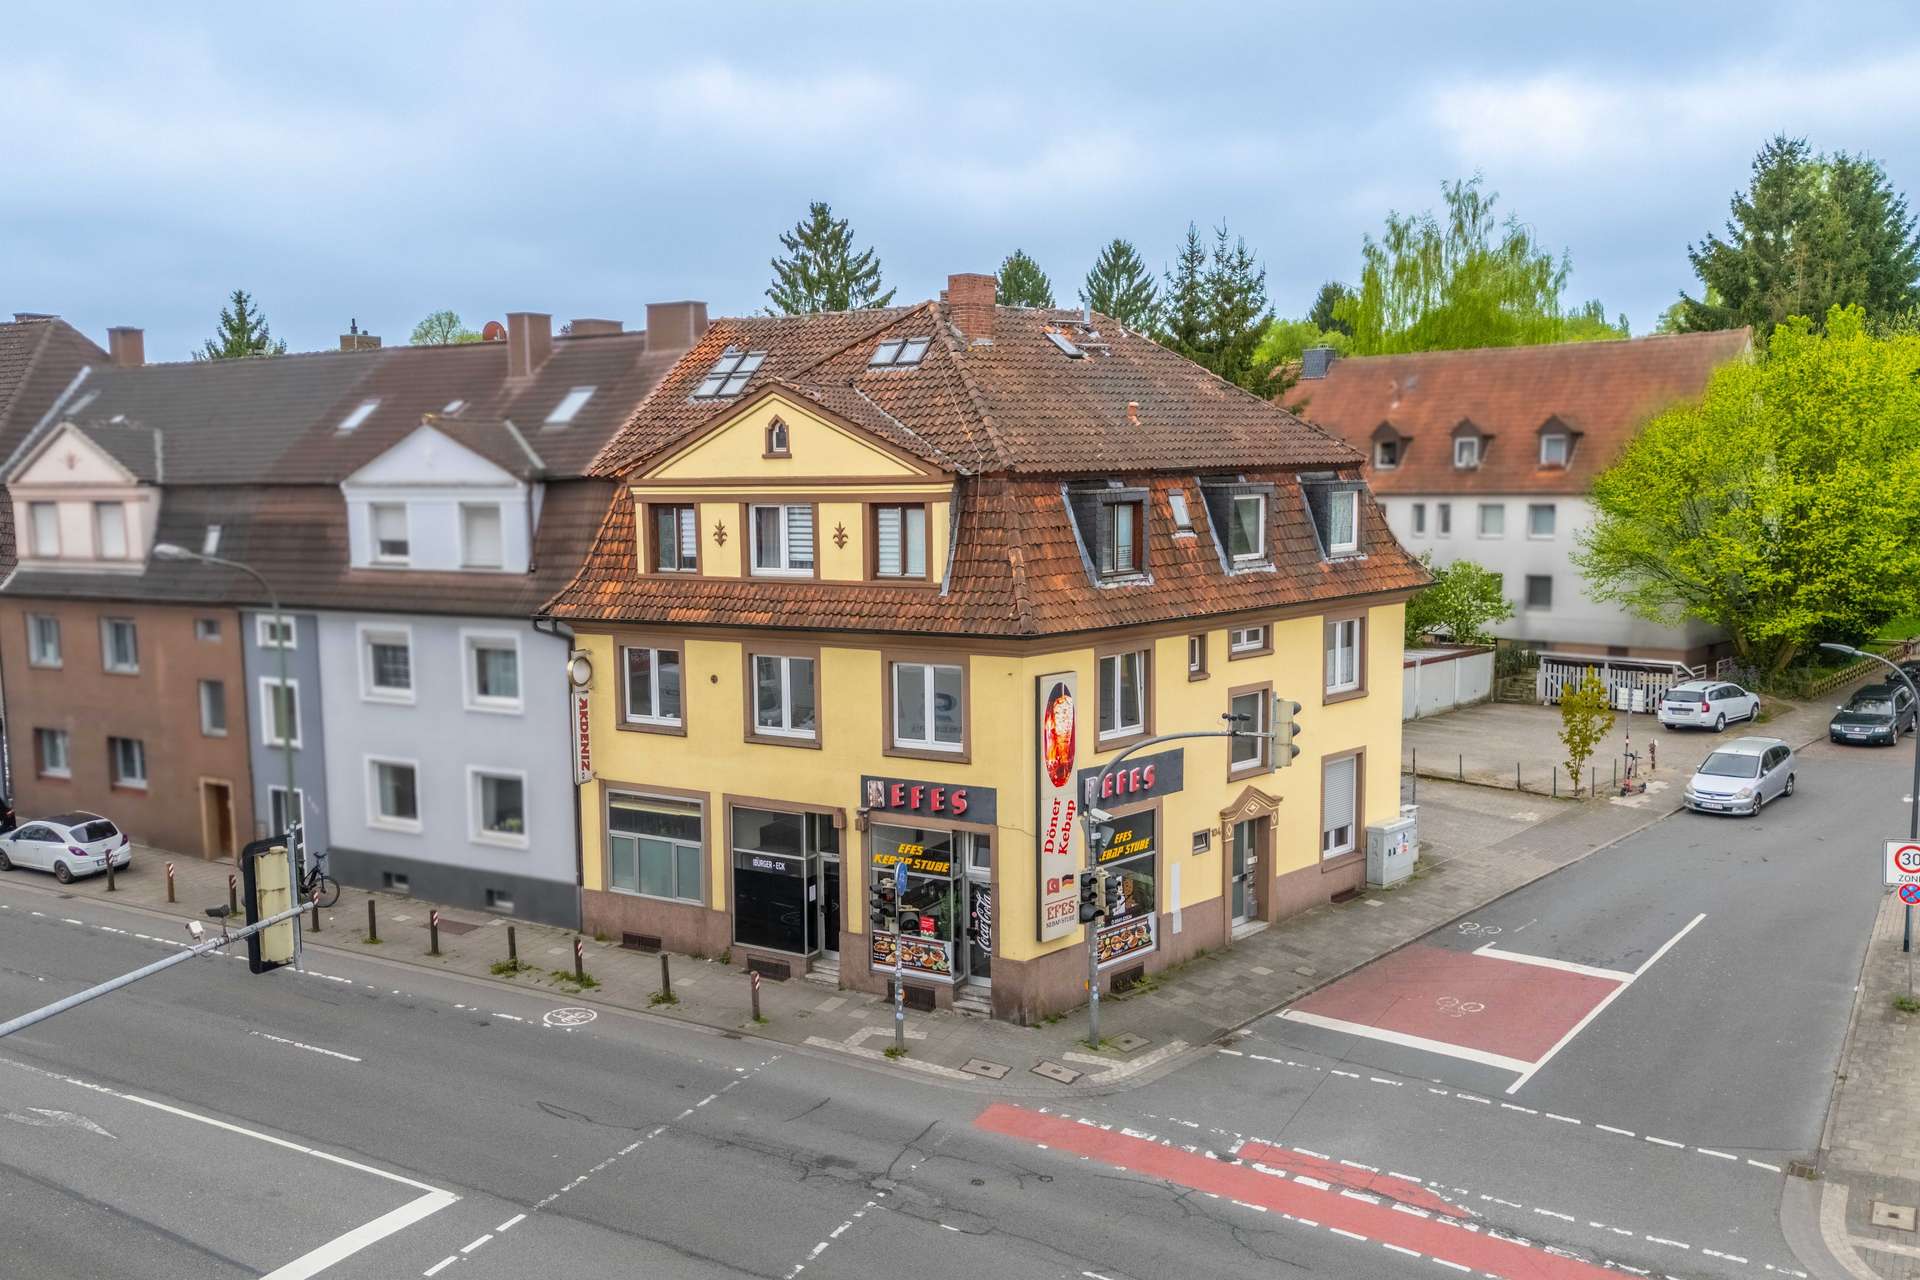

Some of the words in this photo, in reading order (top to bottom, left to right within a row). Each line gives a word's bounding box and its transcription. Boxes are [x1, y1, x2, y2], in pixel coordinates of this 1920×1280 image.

[579, 697, 590, 771] AKDENIZ
[1102, 764, 1155, 799] EFES
[891, 783, 967, 815] EFES
[1044, 797, 1061, 854] Döner
[1058, 800, 1076, 855] Kebap
[1114, 830, 1133, 844] EFES
[898, 843, 924, 856] EFES
[1099, 846, 1124, 862] EBAP
[1124, 837, 1150, 855] STUBE
[1902, 853, 1920, 866] 30
[912, 858, 950, 873] STUBE
[1898, 874, 1920, 883] ZON
[1047, 900, 1075, 920] EFES
